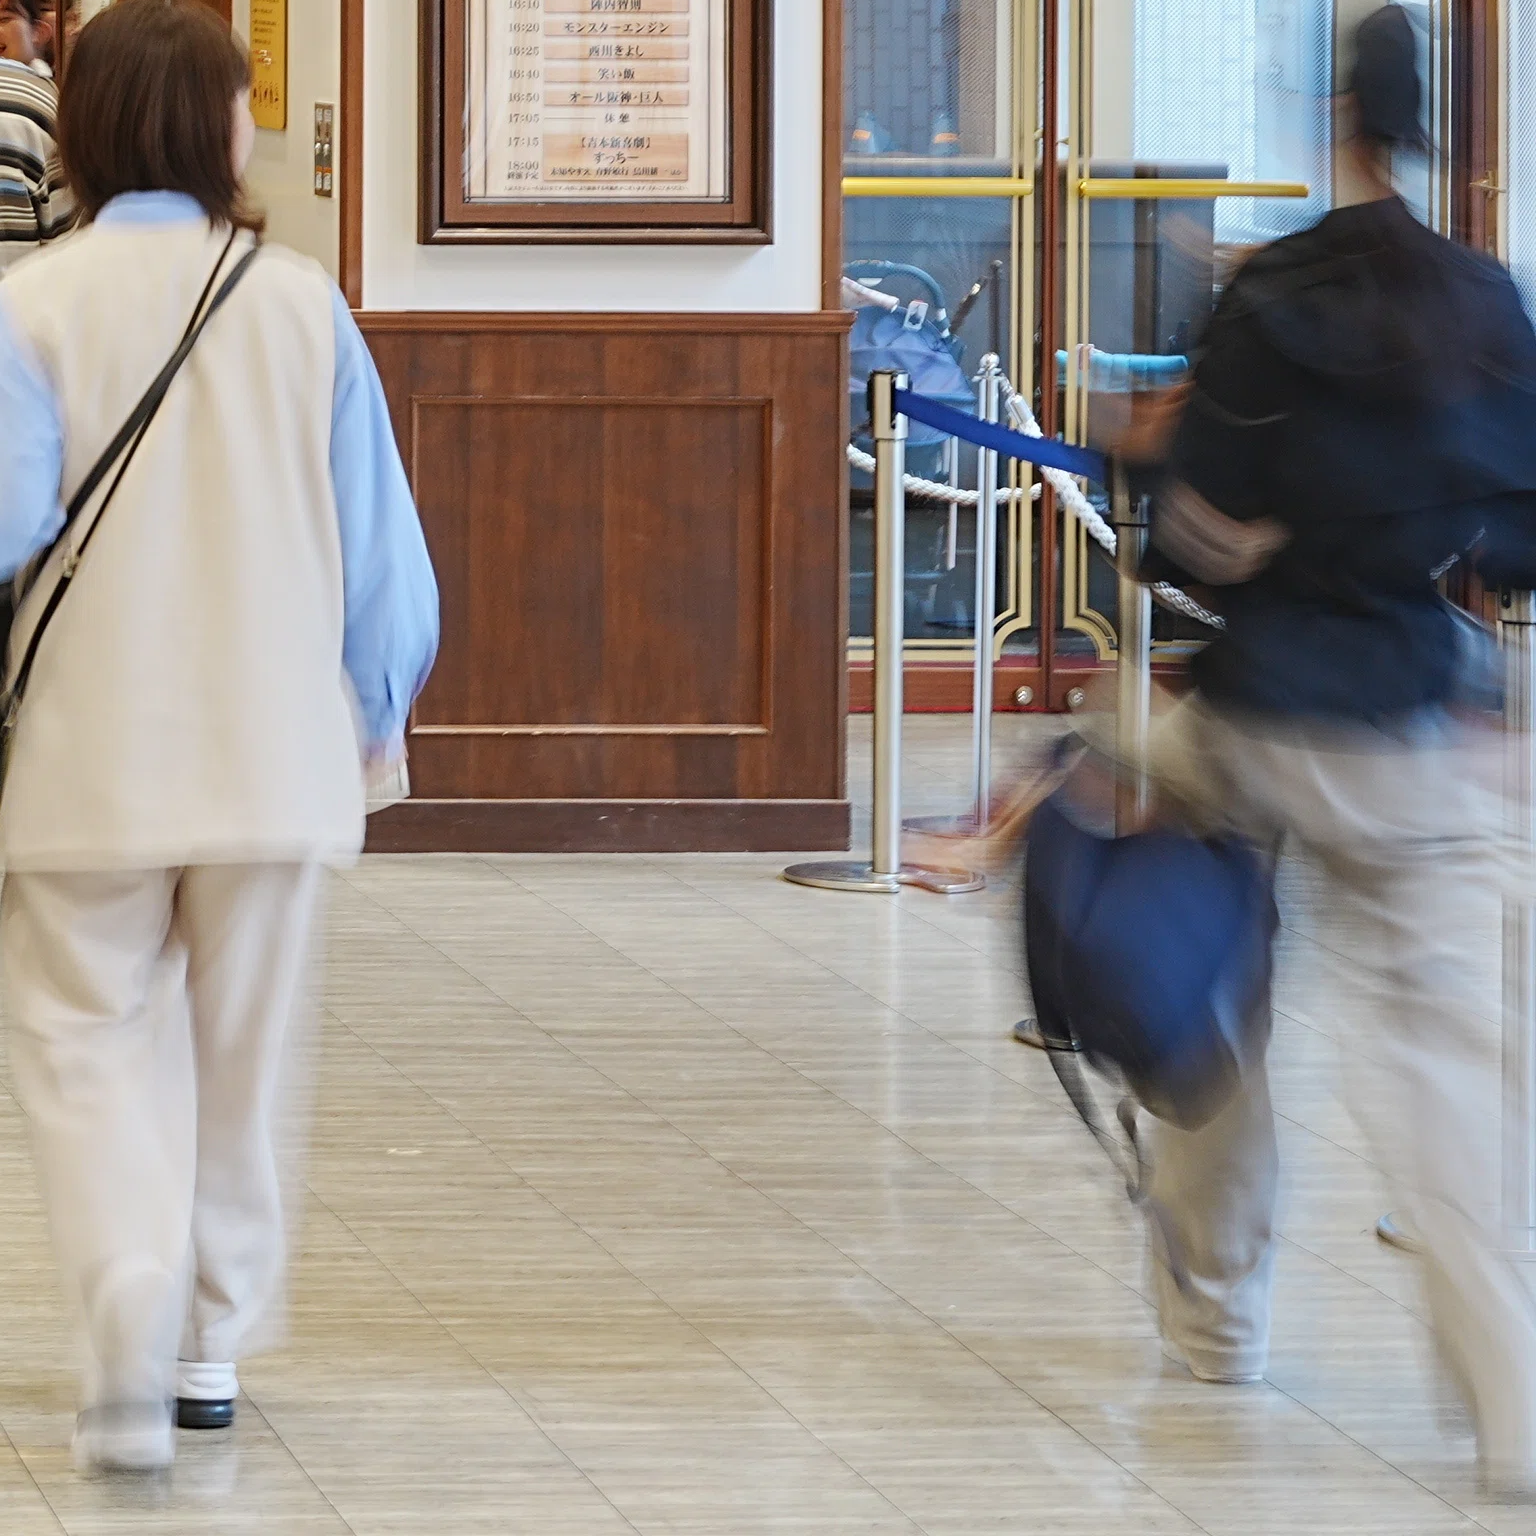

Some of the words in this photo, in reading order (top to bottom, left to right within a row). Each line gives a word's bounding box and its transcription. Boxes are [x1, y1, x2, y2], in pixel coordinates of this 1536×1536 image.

[508, 0, 540, 10] 16:10
[508, 22, 540, 33] 16:20
[564, 21, 670, 34] モンスターエンジン
[508, 46, 540, 57] 16:25
[588, 44, 645, 58] 西川きよし
[508, 69, 540, 80] 16:40
[508, 92, 540, 103] 16:50
[508, 114, 540, 124] 17:05
[508, 137, 540, 148] 17:15
[594, 151, 640, 165] すっちー
